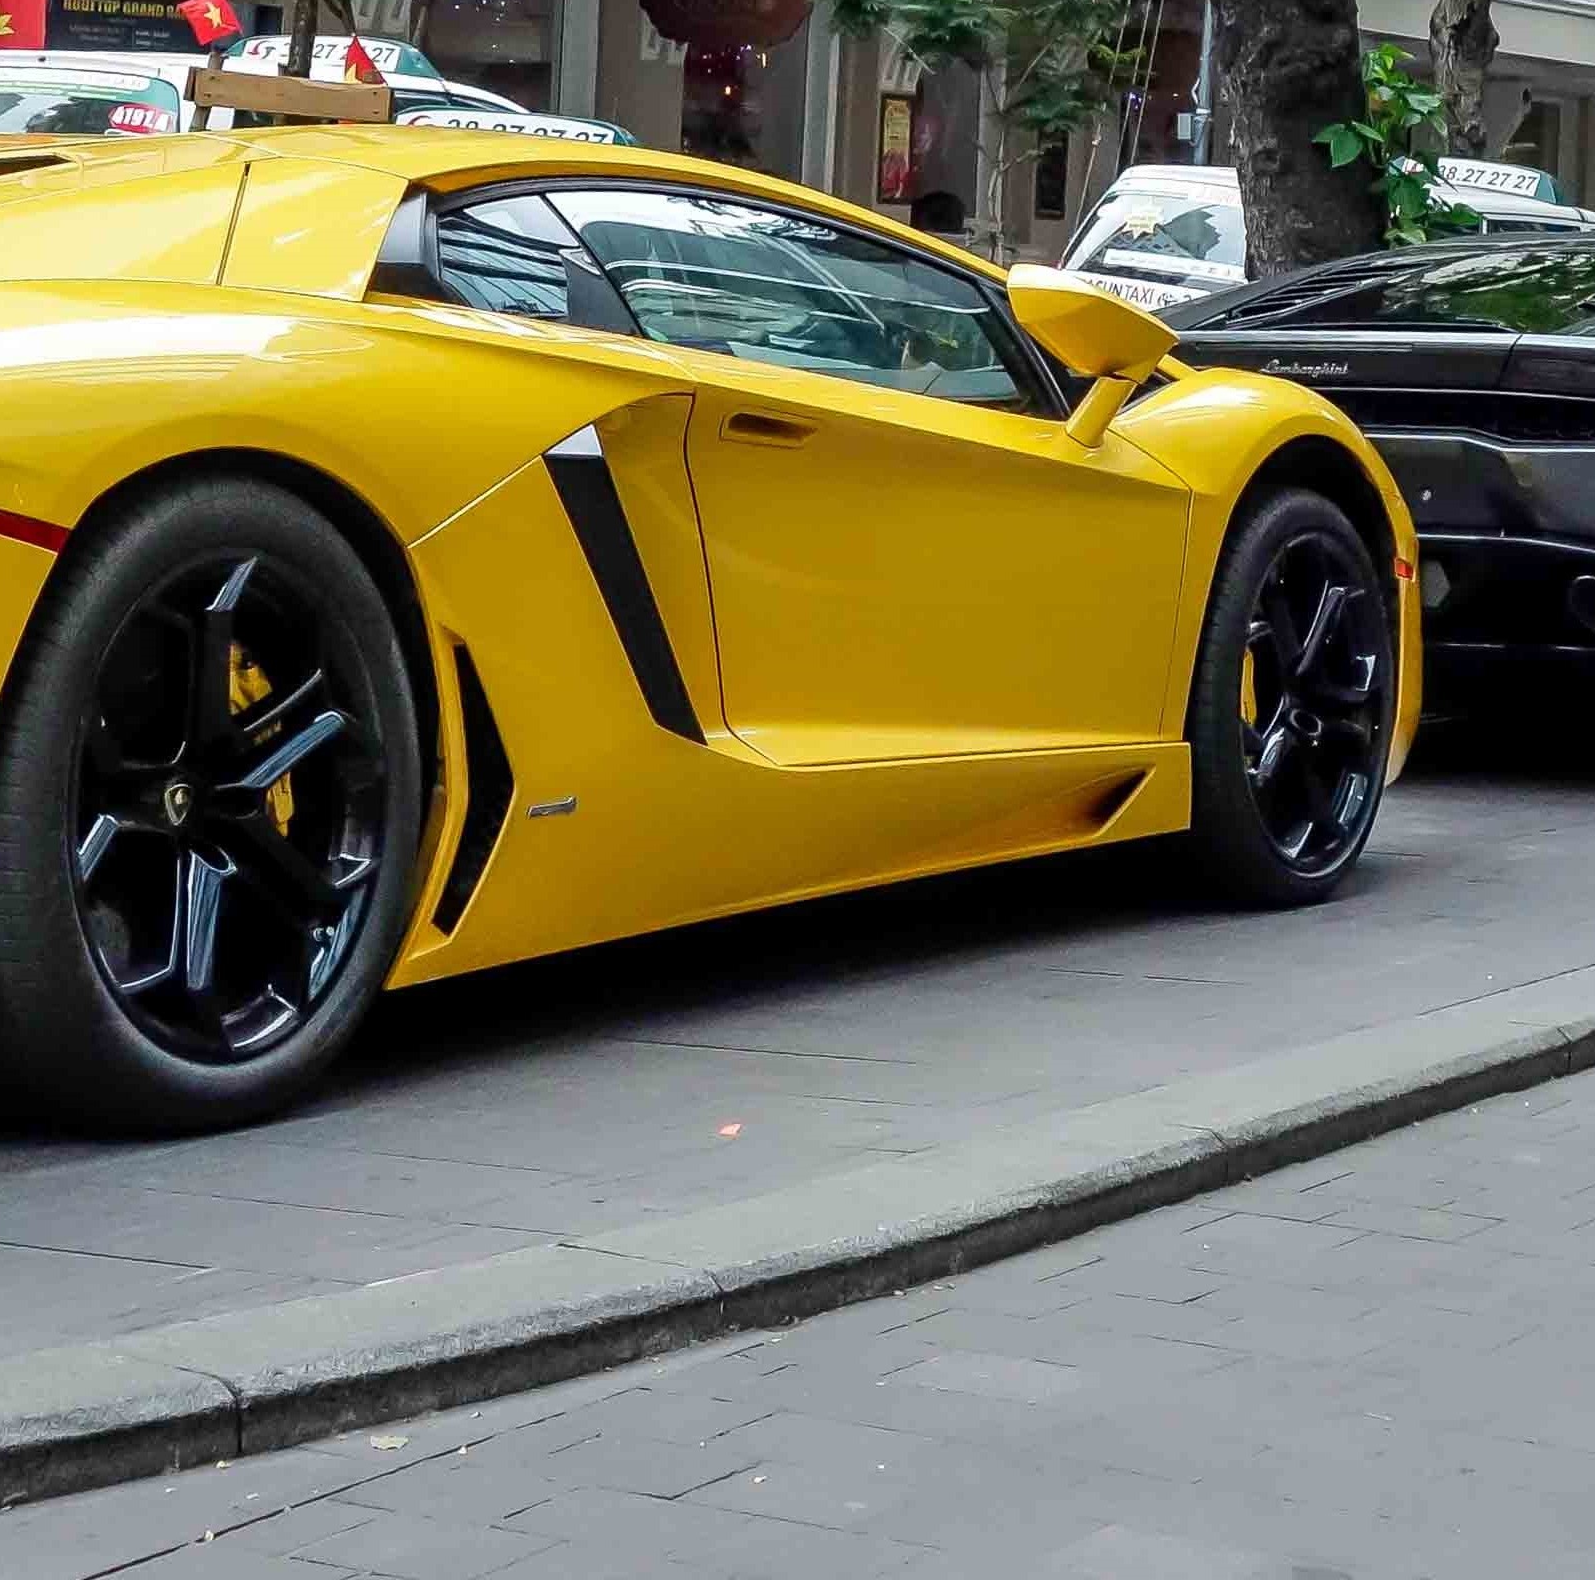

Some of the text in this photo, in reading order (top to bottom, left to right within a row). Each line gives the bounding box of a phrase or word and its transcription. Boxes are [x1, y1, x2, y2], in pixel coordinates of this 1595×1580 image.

[371, 47, 396, 63] 27
[1487, 170, 1509, 188] 27
[1513, 174, 1537, 191] 27
